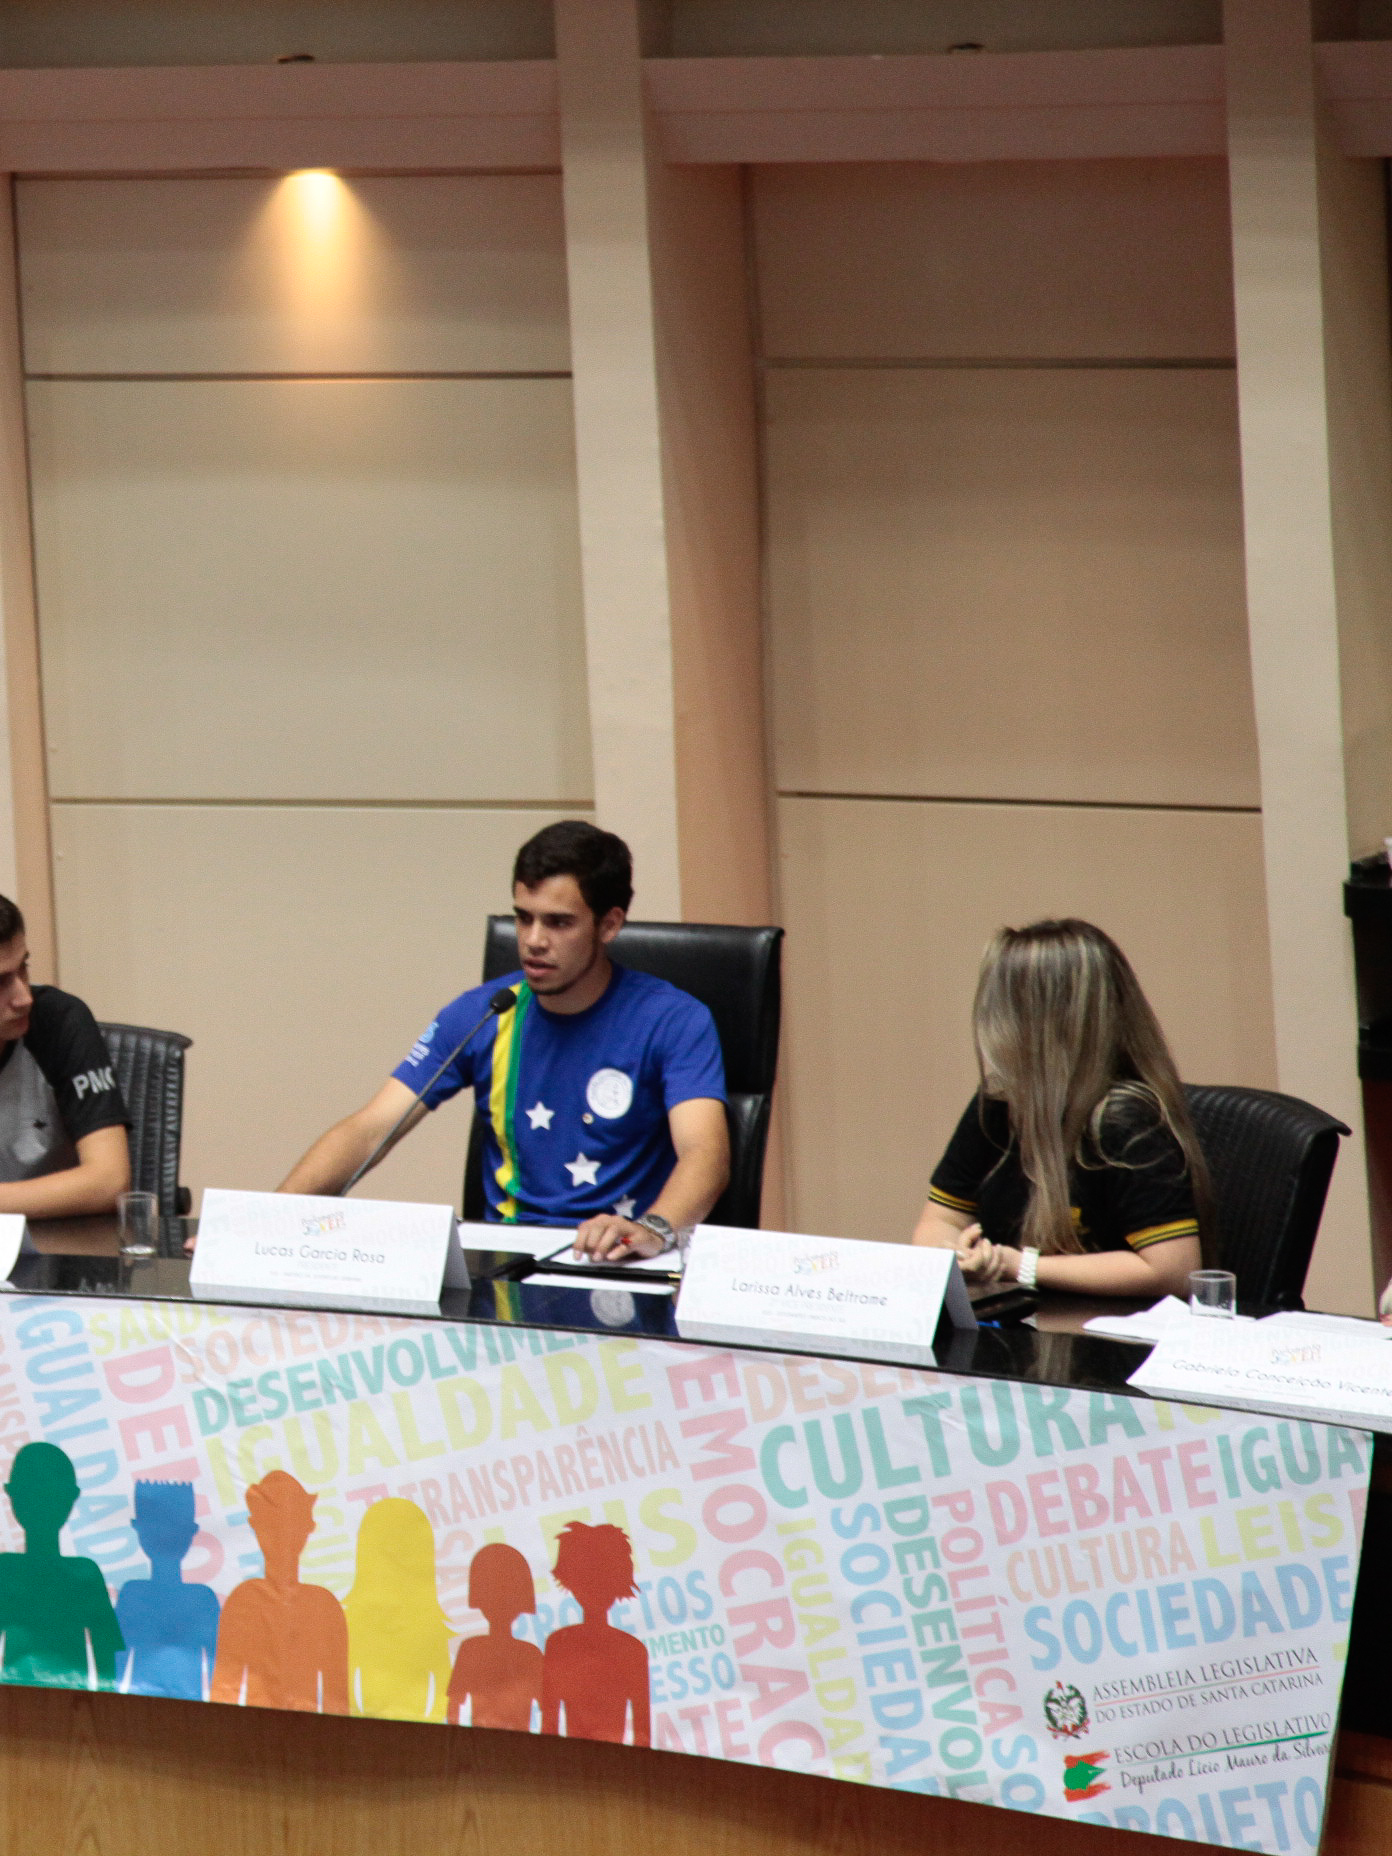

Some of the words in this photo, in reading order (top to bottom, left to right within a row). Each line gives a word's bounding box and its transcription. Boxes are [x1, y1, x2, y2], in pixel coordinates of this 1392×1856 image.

[255, 1241, 294, 1257] Lucas
[353, 1248, 385, 1264] Rosa
[731, 1278, 780, 1296] Larissa
[785, 1284, 822, 1300] Alves
[758, 1381, 1147, 1510] CULTURA
[985, 1438, 1218, 1548] DEBATE
[1200, 1492, 1346, 1569] LEIS
[1008, 1521, 1198, 1604] CULTURA
[1023, 1555, 1352, 1672] SOCIEDADE
[1092, 1669, 1195, 1702] ASSEMBLEIA
[1200, 1647, 1319, 1682] LEGISLATIVA
[1095, 1708, 1116, 1724] DO
[1121, 1698, 1174, 1720] ESTADO
[1178, 1692, 1197, 1710] DE
[1202, 1685, 1249, 1706] SANTA
[1251, 1672, 1324, 1697] CATARINA
[1114, 1737, 1186, 1765] ESCOLA
[1188, 1731, 1217, 1750] DO
[1222, 1712, 1332, 1745] LEGISLATIVO
[1120, 1760, 1185, 1796] Deputado
[1271, 1745, 1290, 1763] da
